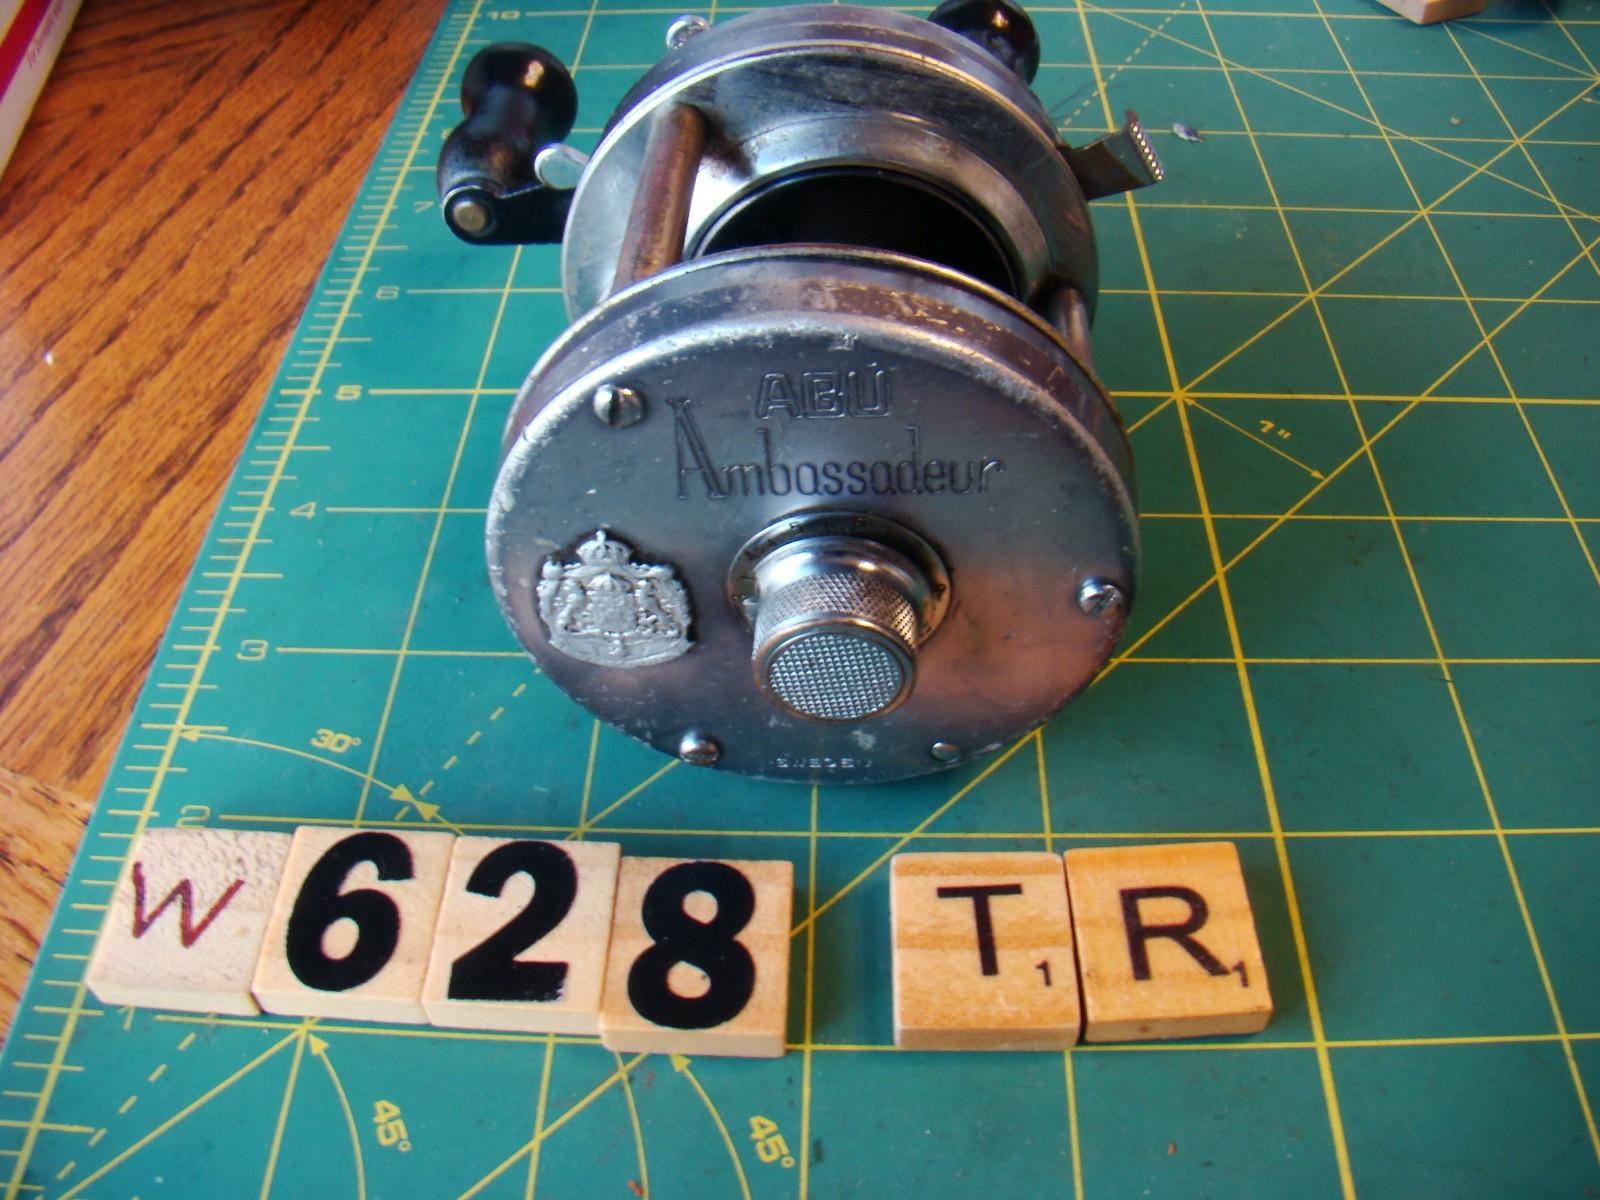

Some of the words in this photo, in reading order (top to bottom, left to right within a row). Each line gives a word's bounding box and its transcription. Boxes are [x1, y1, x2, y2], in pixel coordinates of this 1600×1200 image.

[487, 10, 521, 20] 10
[414, 200, 435, 214] 7
[376, 285, 401, 300] 6
[335, 384, 363, 401] 5
[755, 370, 893, 420] ABU
[665, 397, 1005, 500] Ambassadeur
[288, 501, 318, 519] 4
[235, 639, 270, 662] 3
[175, 804, 212, 830] 2
[1035, 959, 1053, 987] 1
